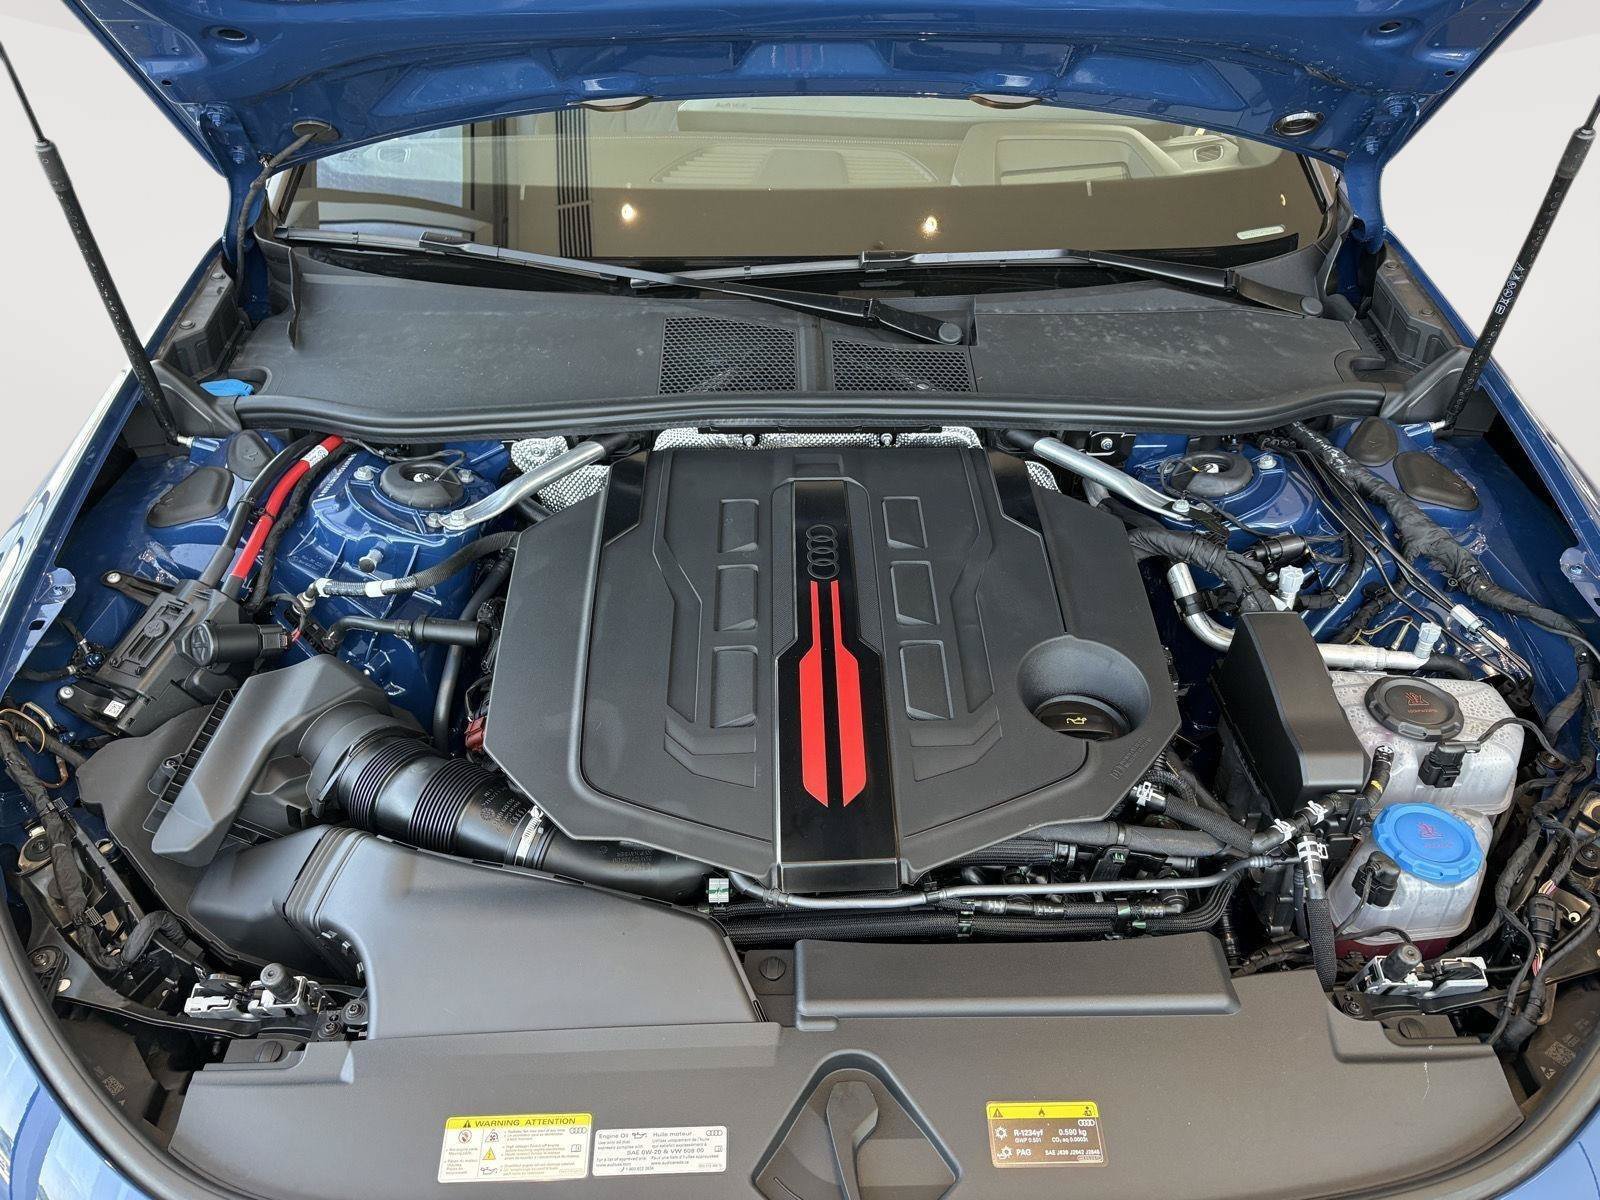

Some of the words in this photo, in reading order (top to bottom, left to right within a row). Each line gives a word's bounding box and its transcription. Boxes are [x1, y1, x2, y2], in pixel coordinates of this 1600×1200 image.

[475, 1119, 520, 1128] WARNING
[524, 1117, 576, 1126] ATTENTION
[1013, 1129, 1043, 1137] R-1234yf
[1078, 1128, 1087, 1137] kg
[1016, 1148, 1032, 1156] PAG
